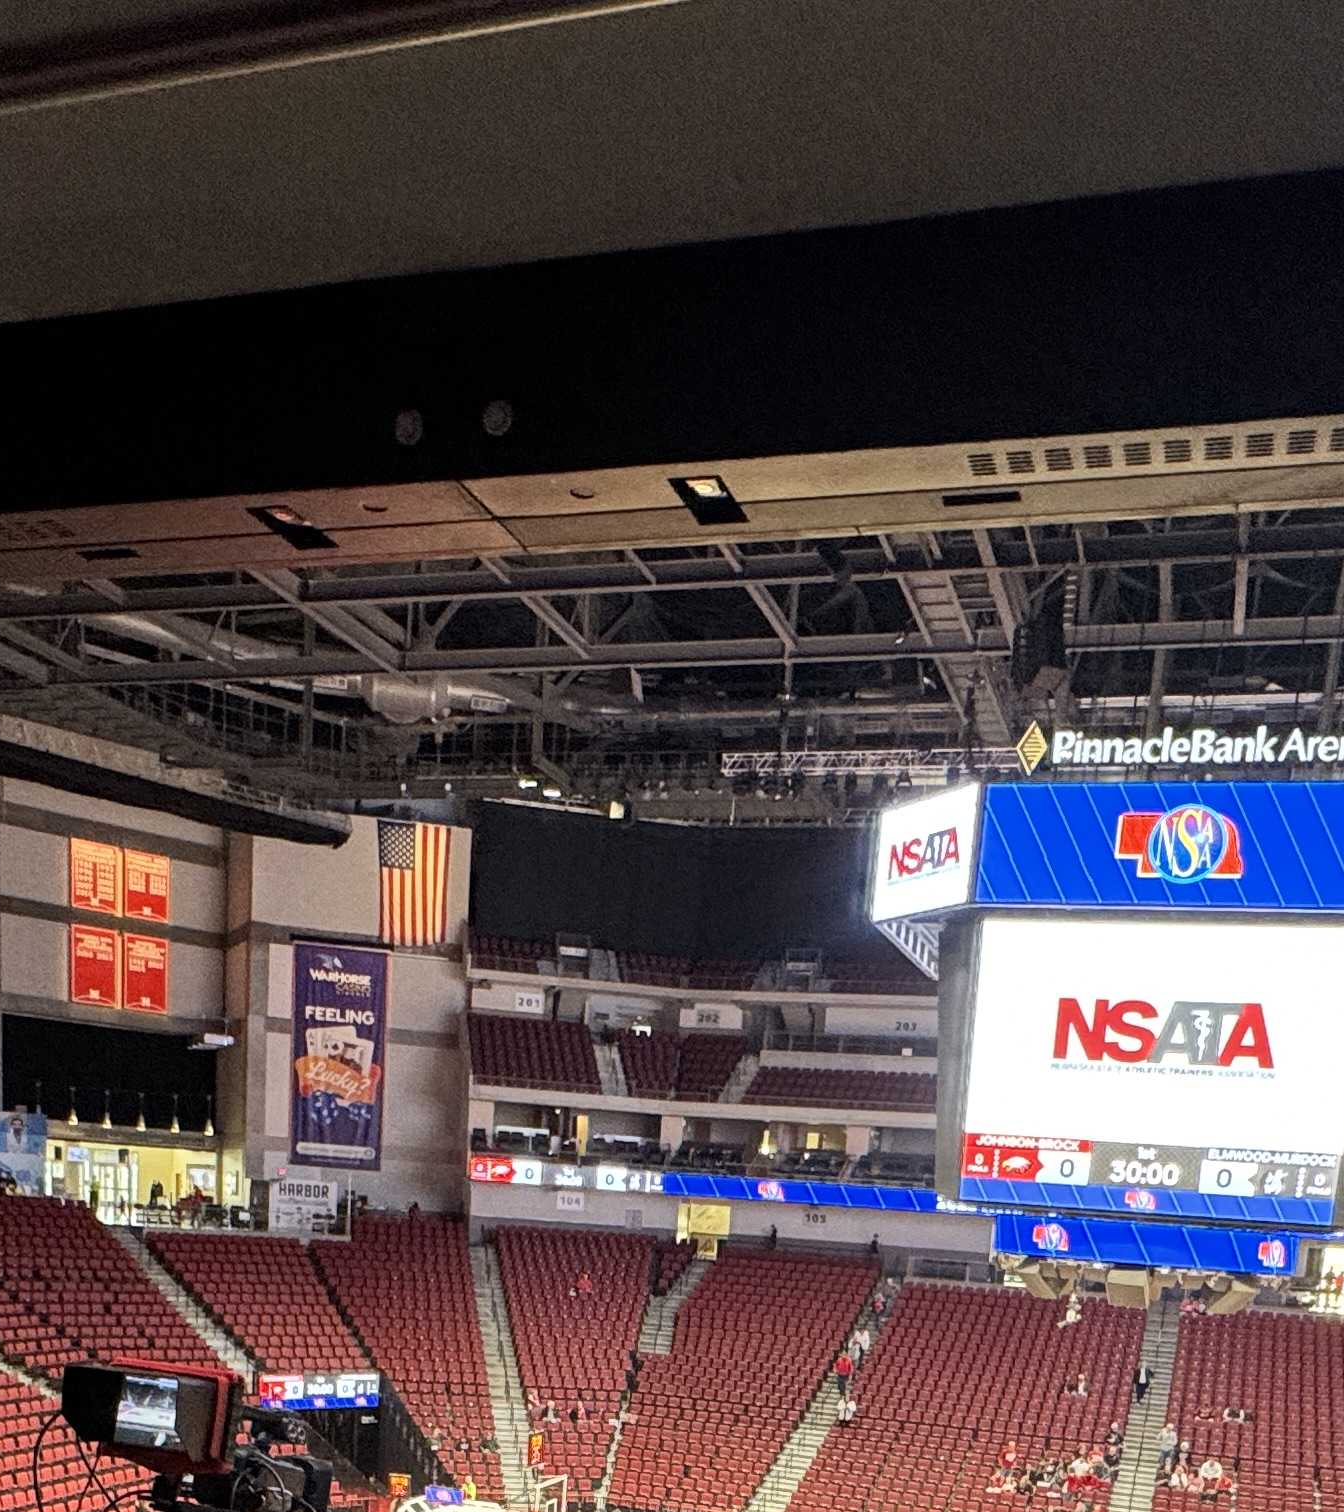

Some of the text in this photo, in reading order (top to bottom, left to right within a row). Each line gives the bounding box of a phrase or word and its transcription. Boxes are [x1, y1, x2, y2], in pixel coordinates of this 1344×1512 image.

[1053, 726, 1277, 764] PinnacleBank
[305, 1005, 375, 1026] FEELING
[1053, 997, 1274, 1069] NSATA
[306, 1061, 371, 1099] Lucky?
[525, 1168, 535, 1180] 0
[1059, 1158, 1075, 1178] 0
[1109, 1159, 1180, 1186] 30:00
[1216, 1168, 1232, 1188] 0
[605, 1173, 614, 1186] 0
